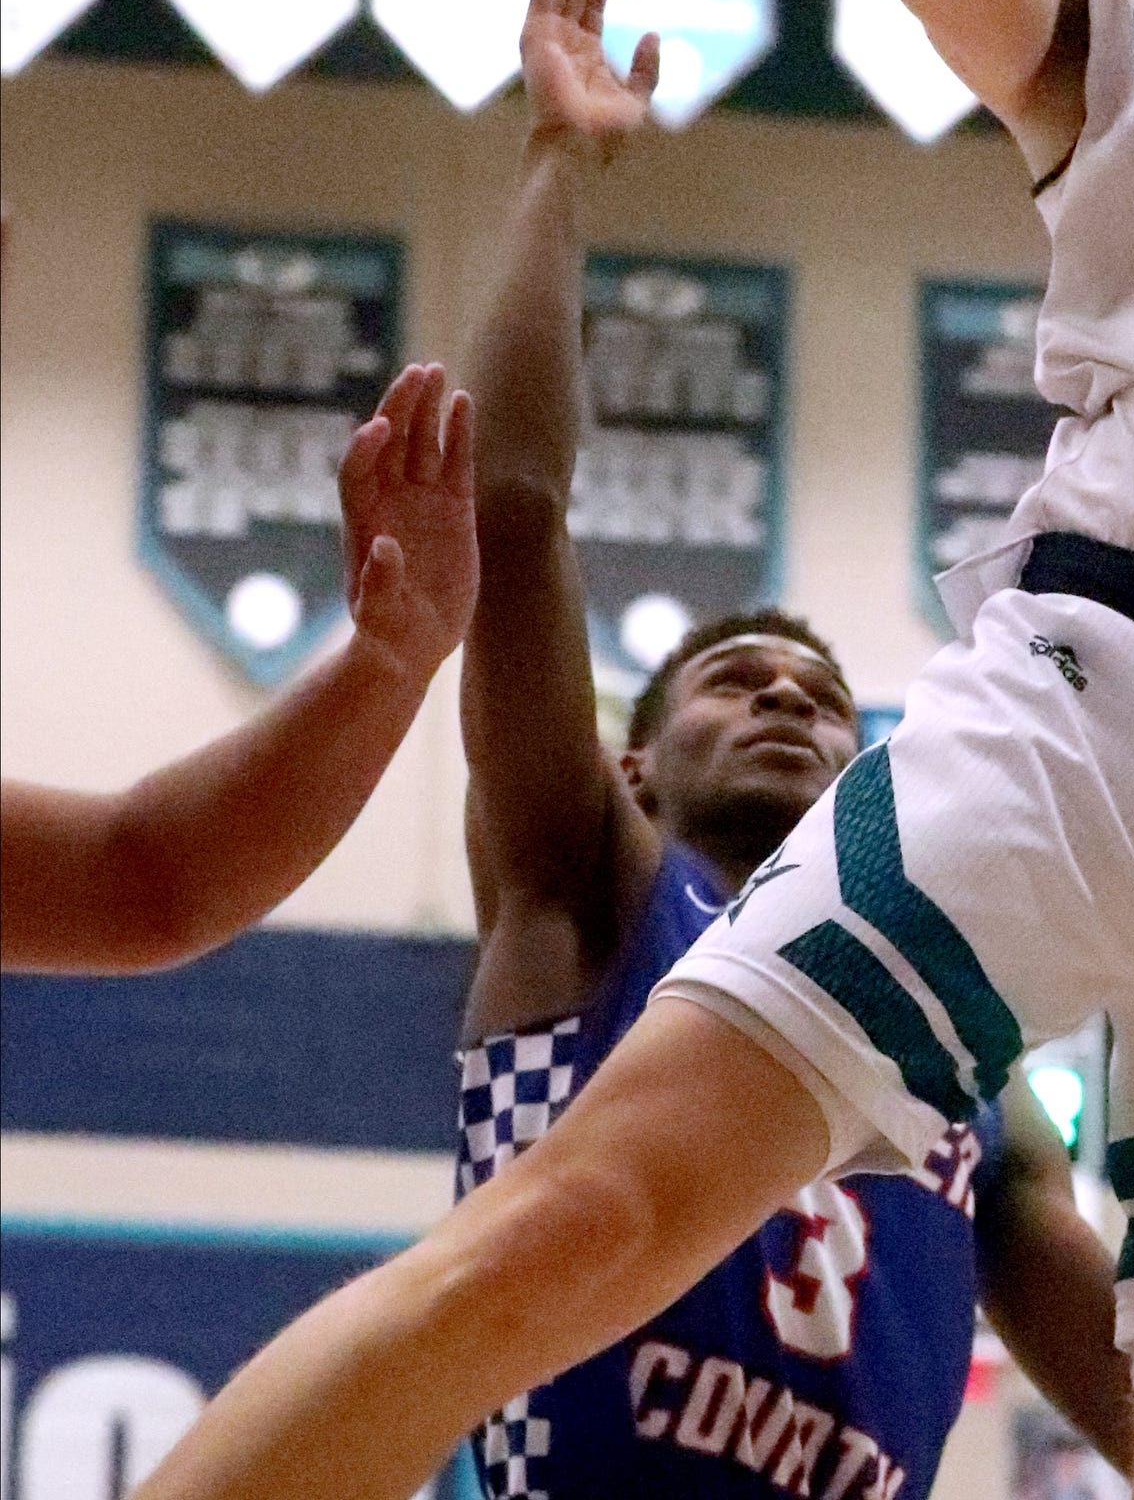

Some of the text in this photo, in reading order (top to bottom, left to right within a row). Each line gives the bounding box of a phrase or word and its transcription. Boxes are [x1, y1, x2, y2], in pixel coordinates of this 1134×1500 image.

[1029, 635, 1088, 692] adidas
[762, 1179, 867, 1362] 3
[628, 1338, 906, 1500] COUNTY
